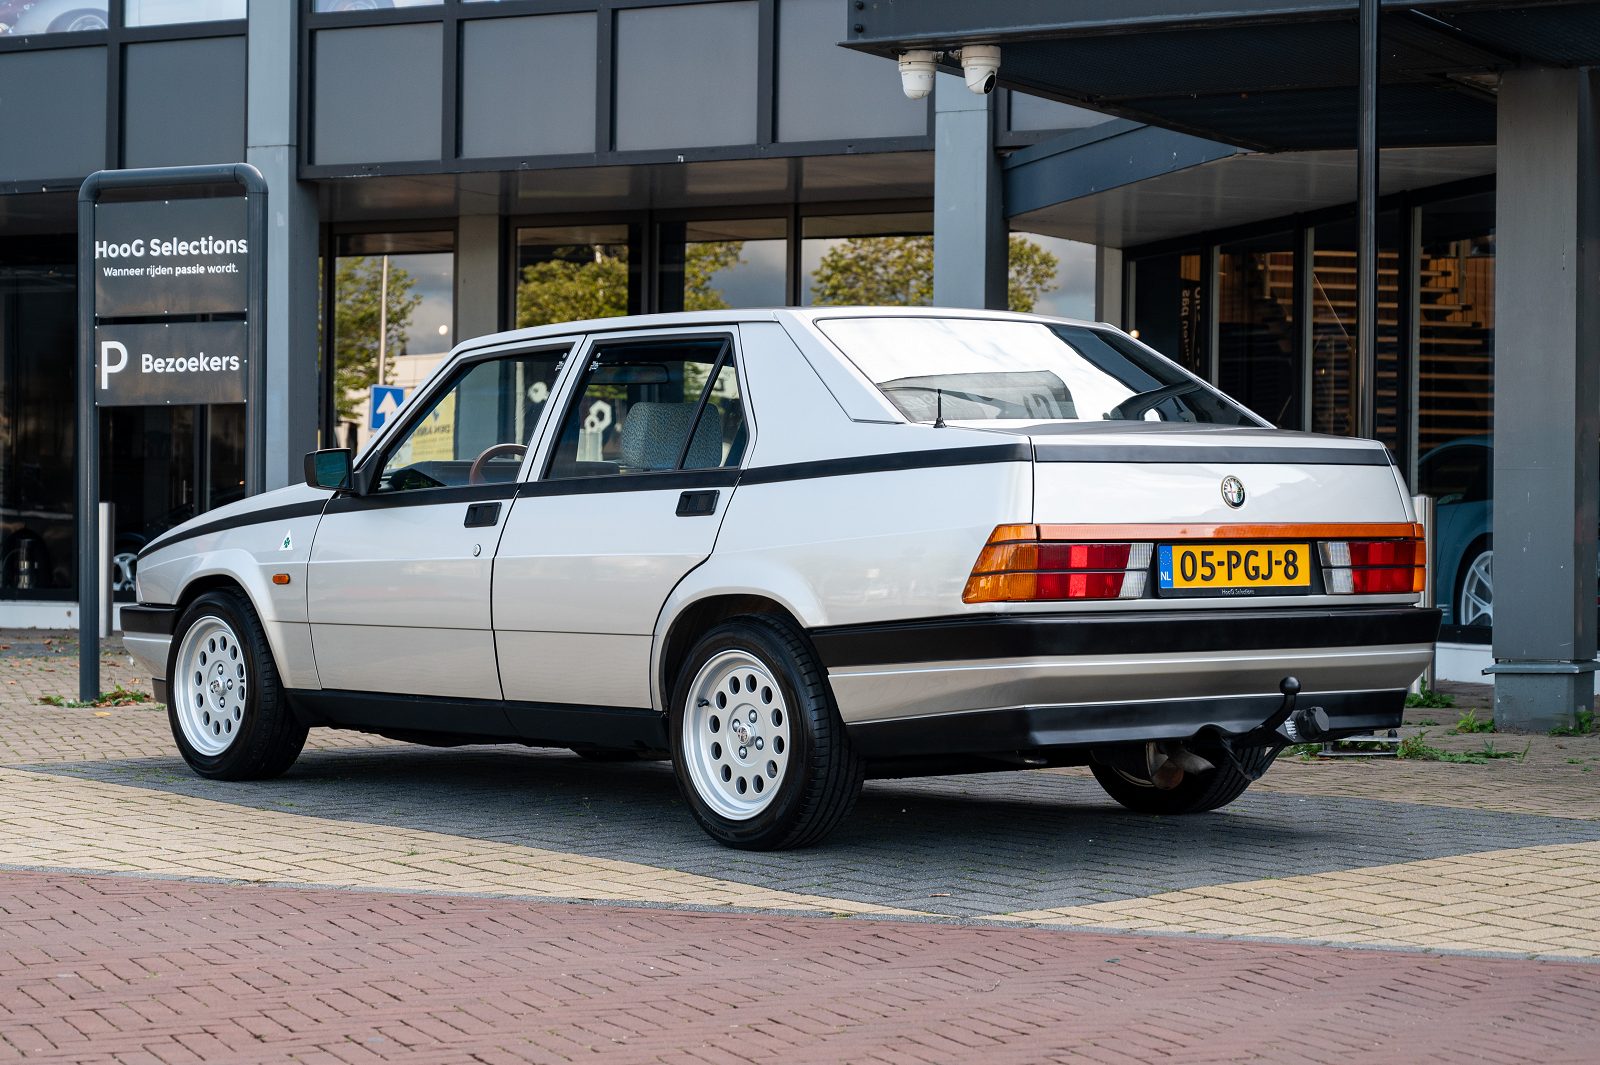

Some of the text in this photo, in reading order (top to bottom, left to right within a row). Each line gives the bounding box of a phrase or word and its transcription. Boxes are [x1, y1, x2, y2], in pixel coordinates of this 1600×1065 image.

[95, 235, 247, 258] HooG Selections
[103, 262, 239, 278] Wanneer rijden passie wordt.
[101, 340, 240, 390] P Bezoekers
[1160, 571, 1172, 581] NL
[1180, 549, 1299, 582] 05-PGJ-8
